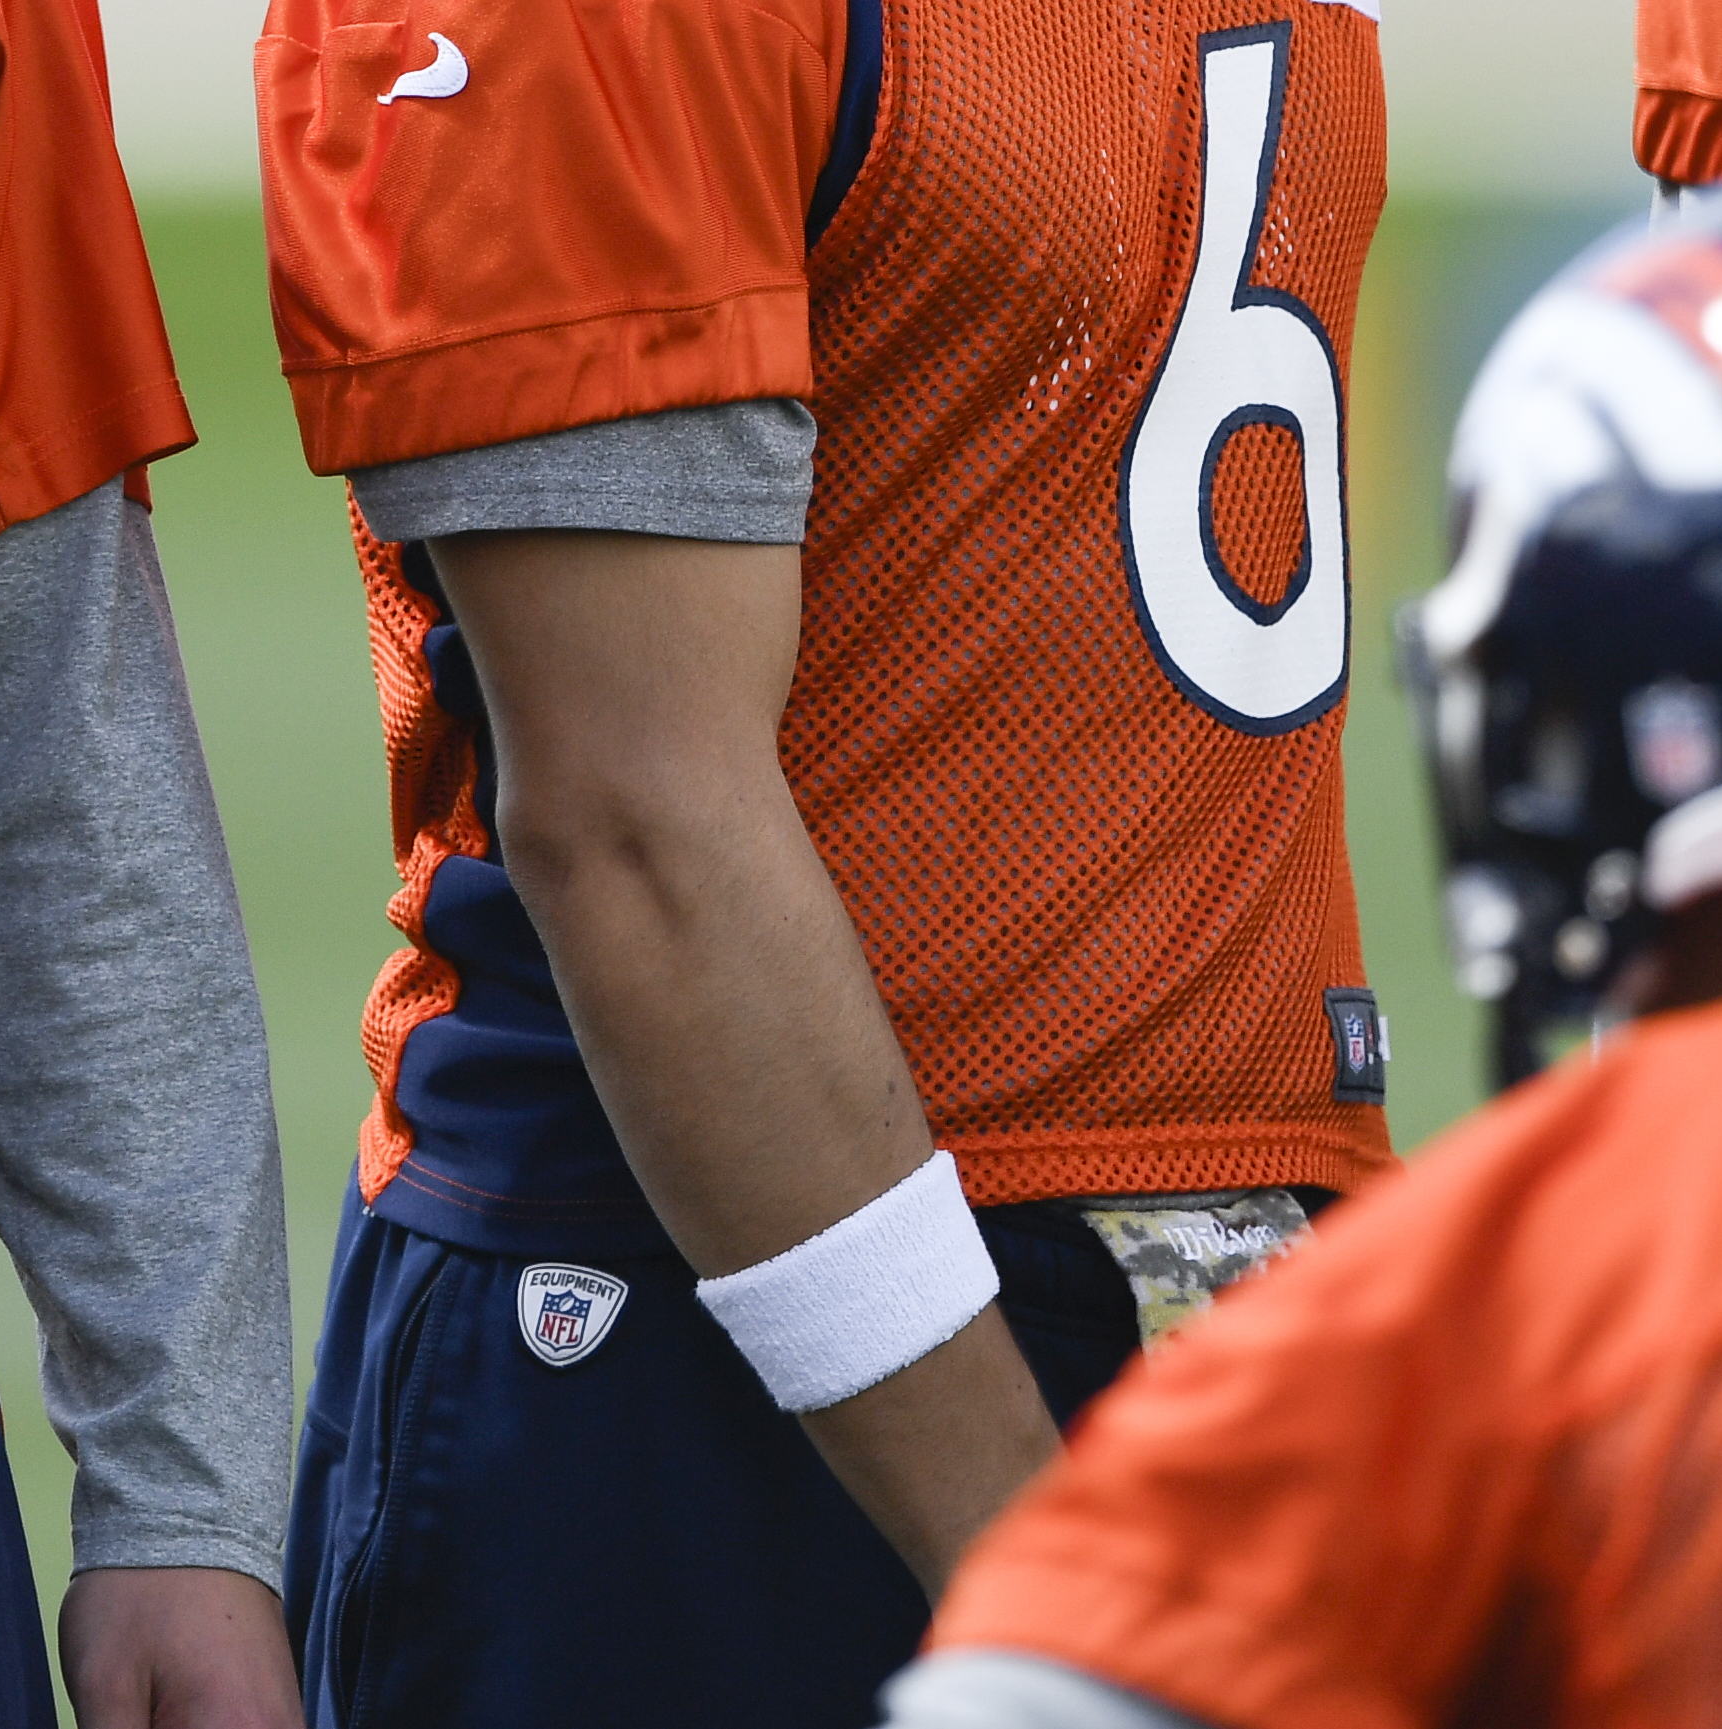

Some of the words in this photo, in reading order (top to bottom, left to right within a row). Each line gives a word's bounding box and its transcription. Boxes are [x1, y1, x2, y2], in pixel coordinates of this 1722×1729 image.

[1117, 20, 1353, 737] 6
[1163, 1218, 1278, 1261] Wilson
[529, 1272, 617, 1301] EQUIPMENT
[539, 1313, 579, 1345] NFL
